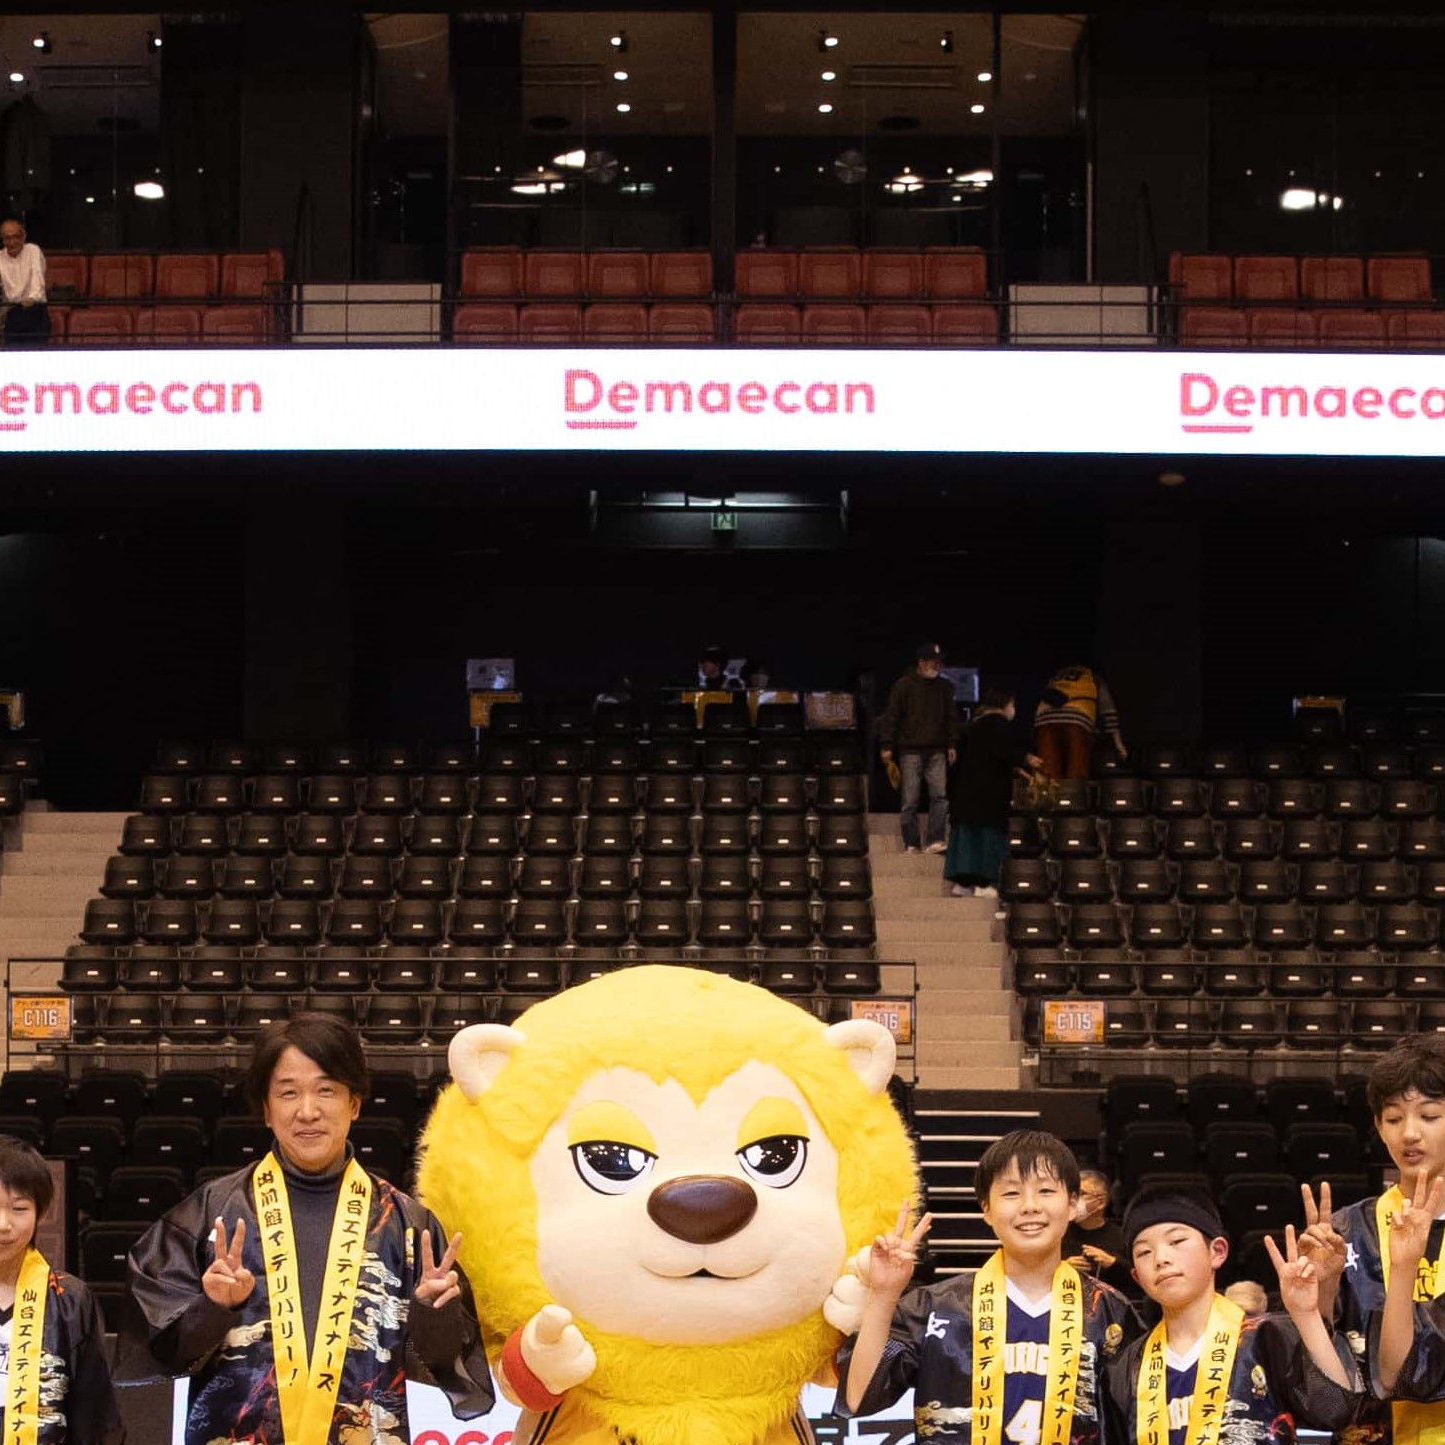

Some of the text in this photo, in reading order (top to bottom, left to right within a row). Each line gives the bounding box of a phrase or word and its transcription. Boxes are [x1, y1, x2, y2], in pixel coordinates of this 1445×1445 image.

[565, 371, 874, 414] Demaecan
[23, 1009, 57, 1027] C116
[317, 1180, 366, 1391] 仙台エイティナイナーズ
